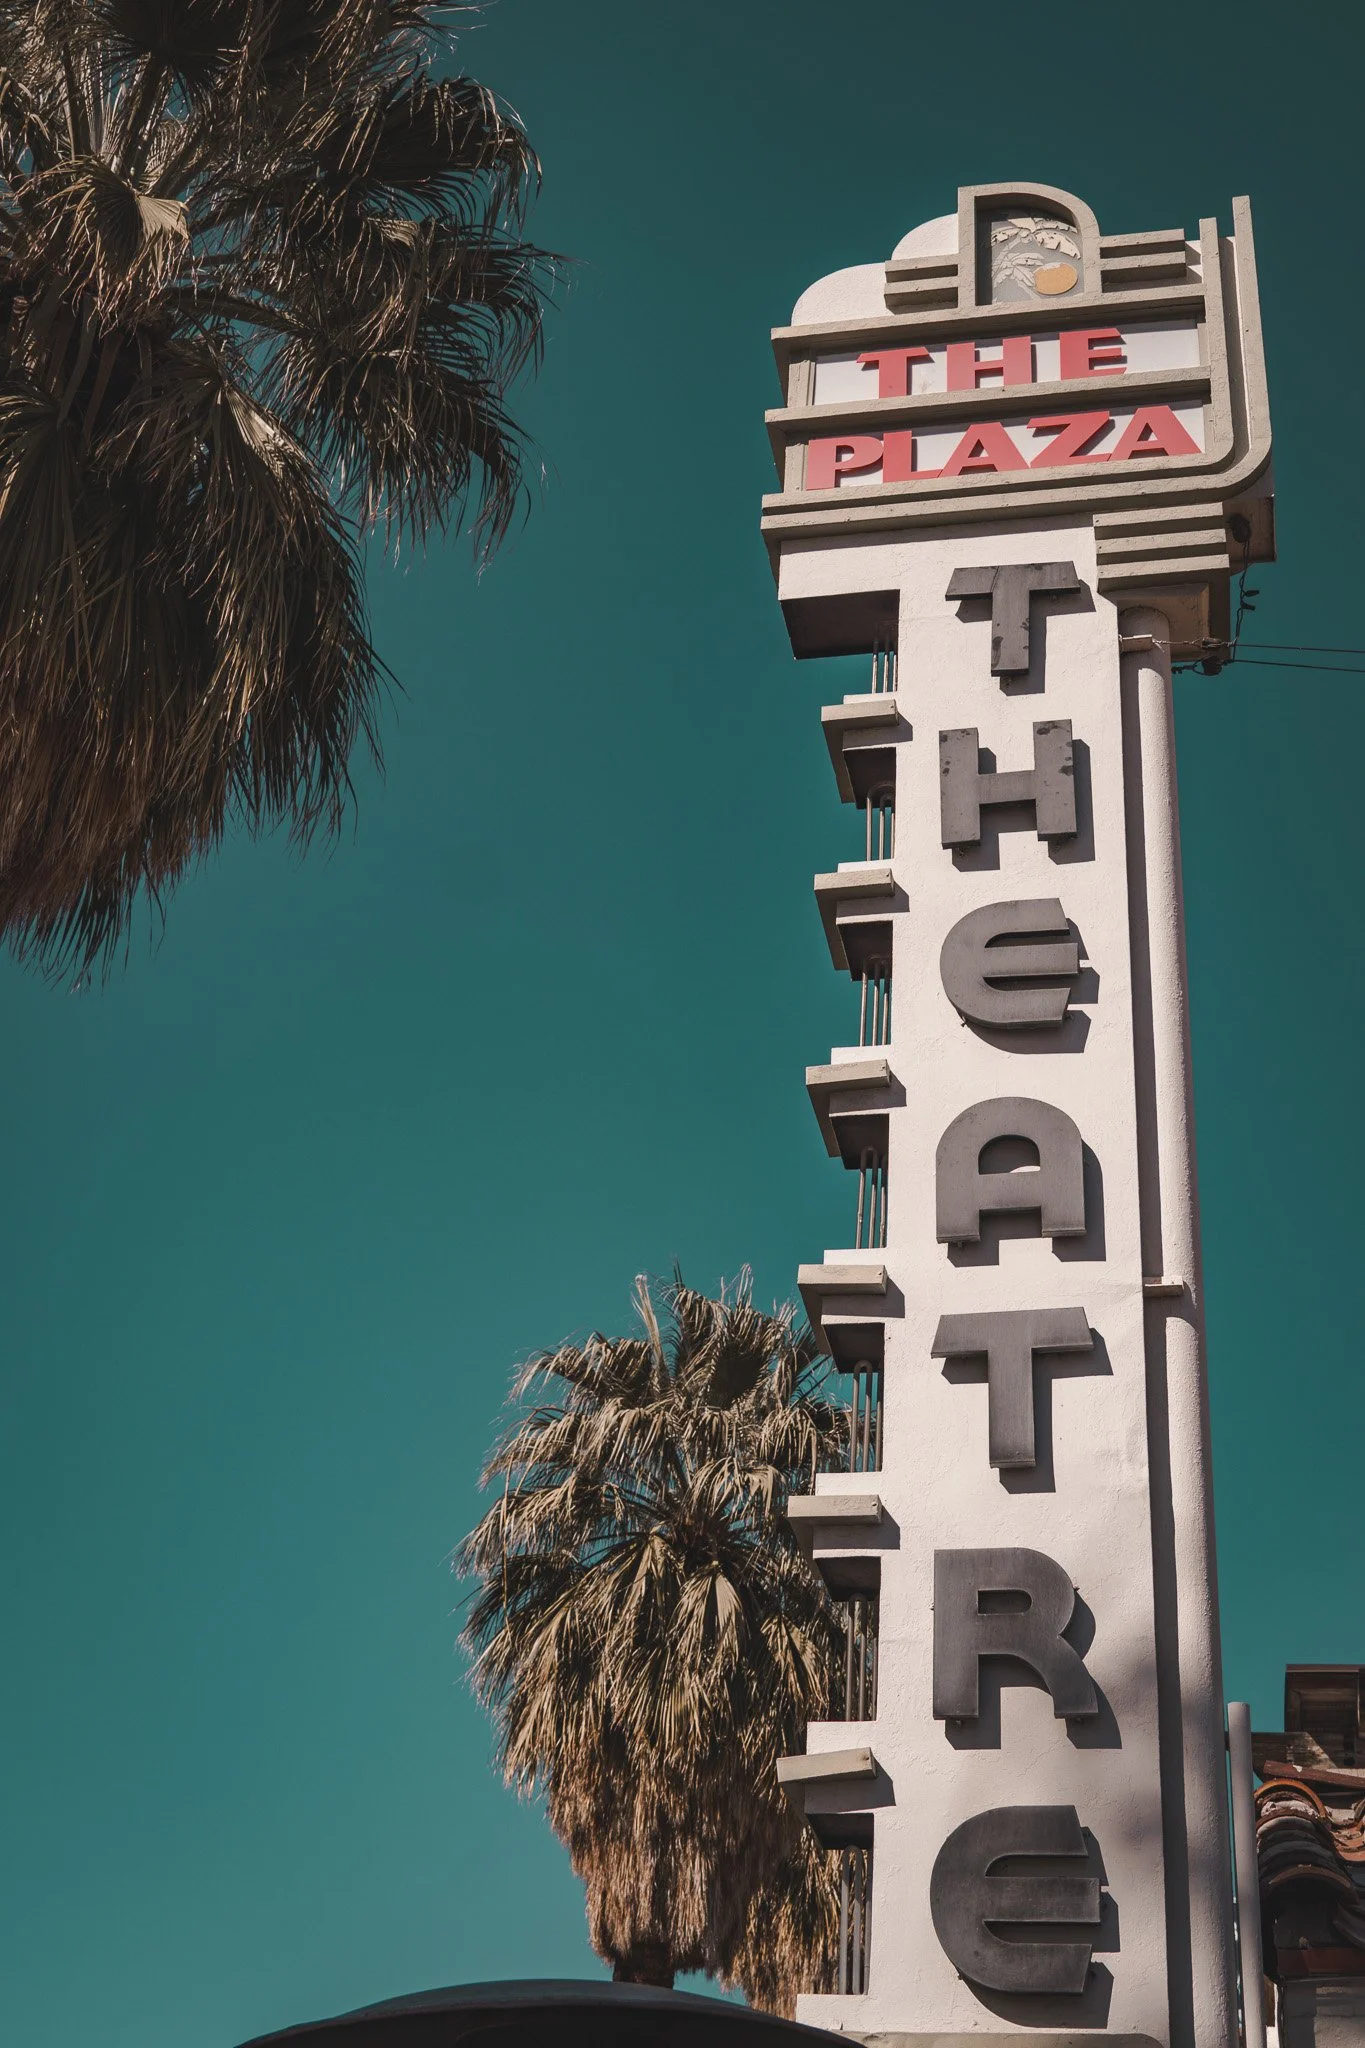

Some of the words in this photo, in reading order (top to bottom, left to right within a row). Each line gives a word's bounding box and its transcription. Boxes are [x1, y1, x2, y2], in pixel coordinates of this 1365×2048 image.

[856, 328, 1127, 399] THE
[806, 405, 1202, 490] PLAZA
[930, 561, 1101, 1995] THEATRE
